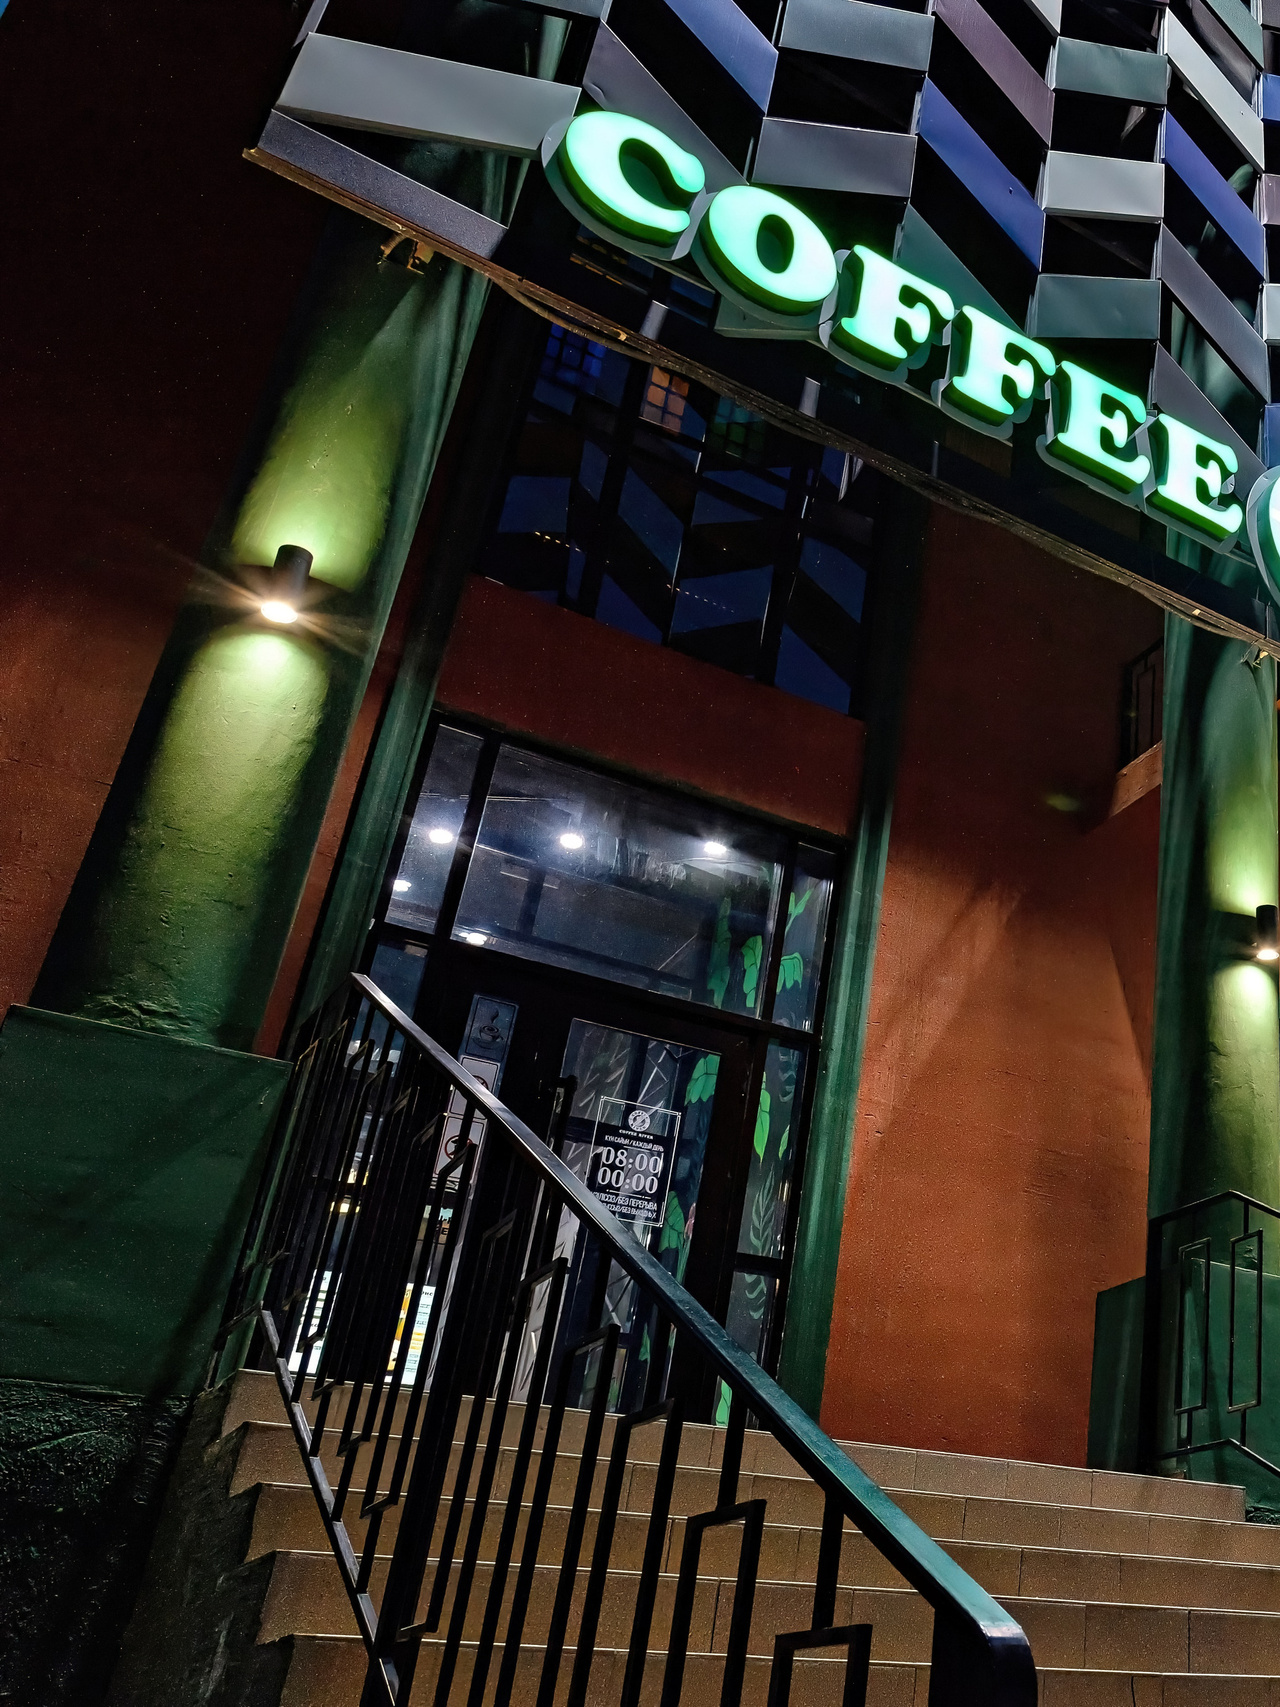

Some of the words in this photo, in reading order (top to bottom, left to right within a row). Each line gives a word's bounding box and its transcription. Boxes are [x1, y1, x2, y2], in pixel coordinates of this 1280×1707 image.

[564, 110, 1243, 541] COFFEE
[602, 1147, 661, 1174] 08:00
[598, 1167, 658, 1194] 00:00
[628, 1199, 657, 1210] ПЕРЕРЫВА
